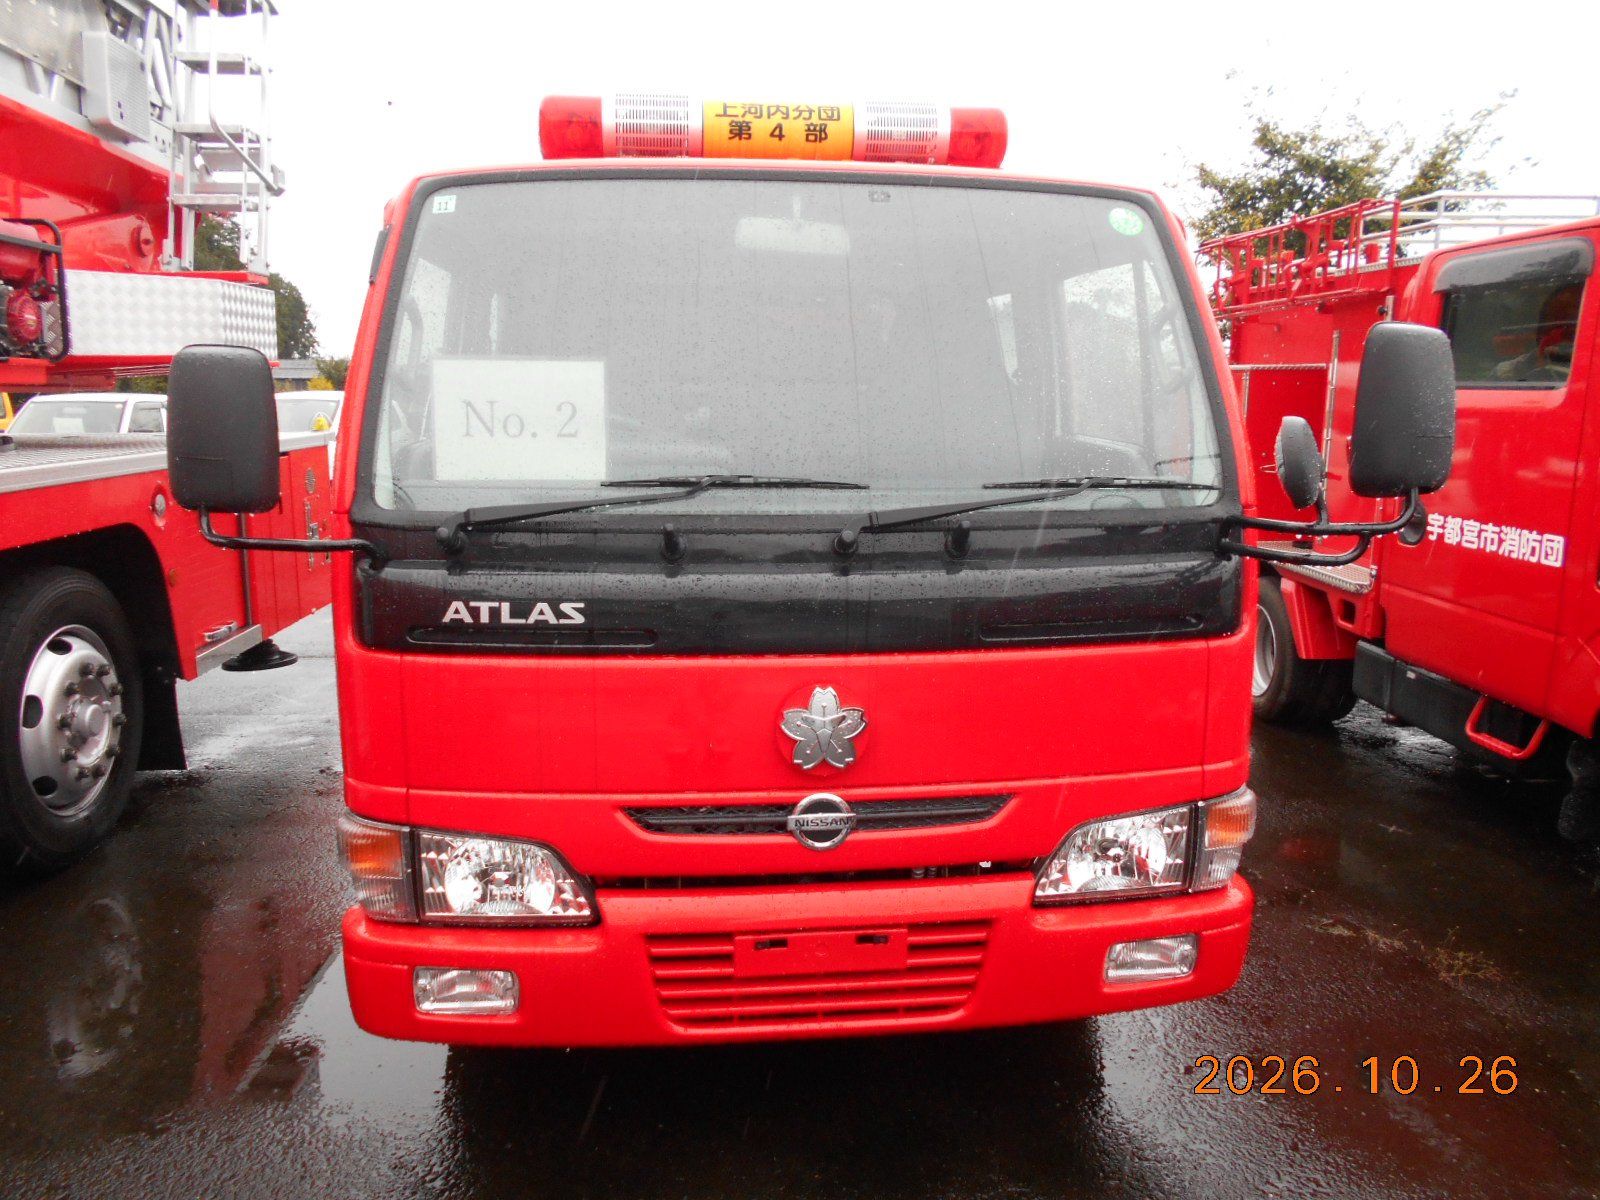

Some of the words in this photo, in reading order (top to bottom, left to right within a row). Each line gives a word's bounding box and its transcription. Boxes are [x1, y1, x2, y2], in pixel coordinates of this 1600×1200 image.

[715, 103, 841, 121] 上河内分団
[461, 399, 538, 438] No.
[556, 401, 578, 438] 2
[1426, 512, 1566, 568] 宇都宮市消防団
[442, 600, 586, 625] ATLAS
[794, 817, 851, 828] NISSAN
